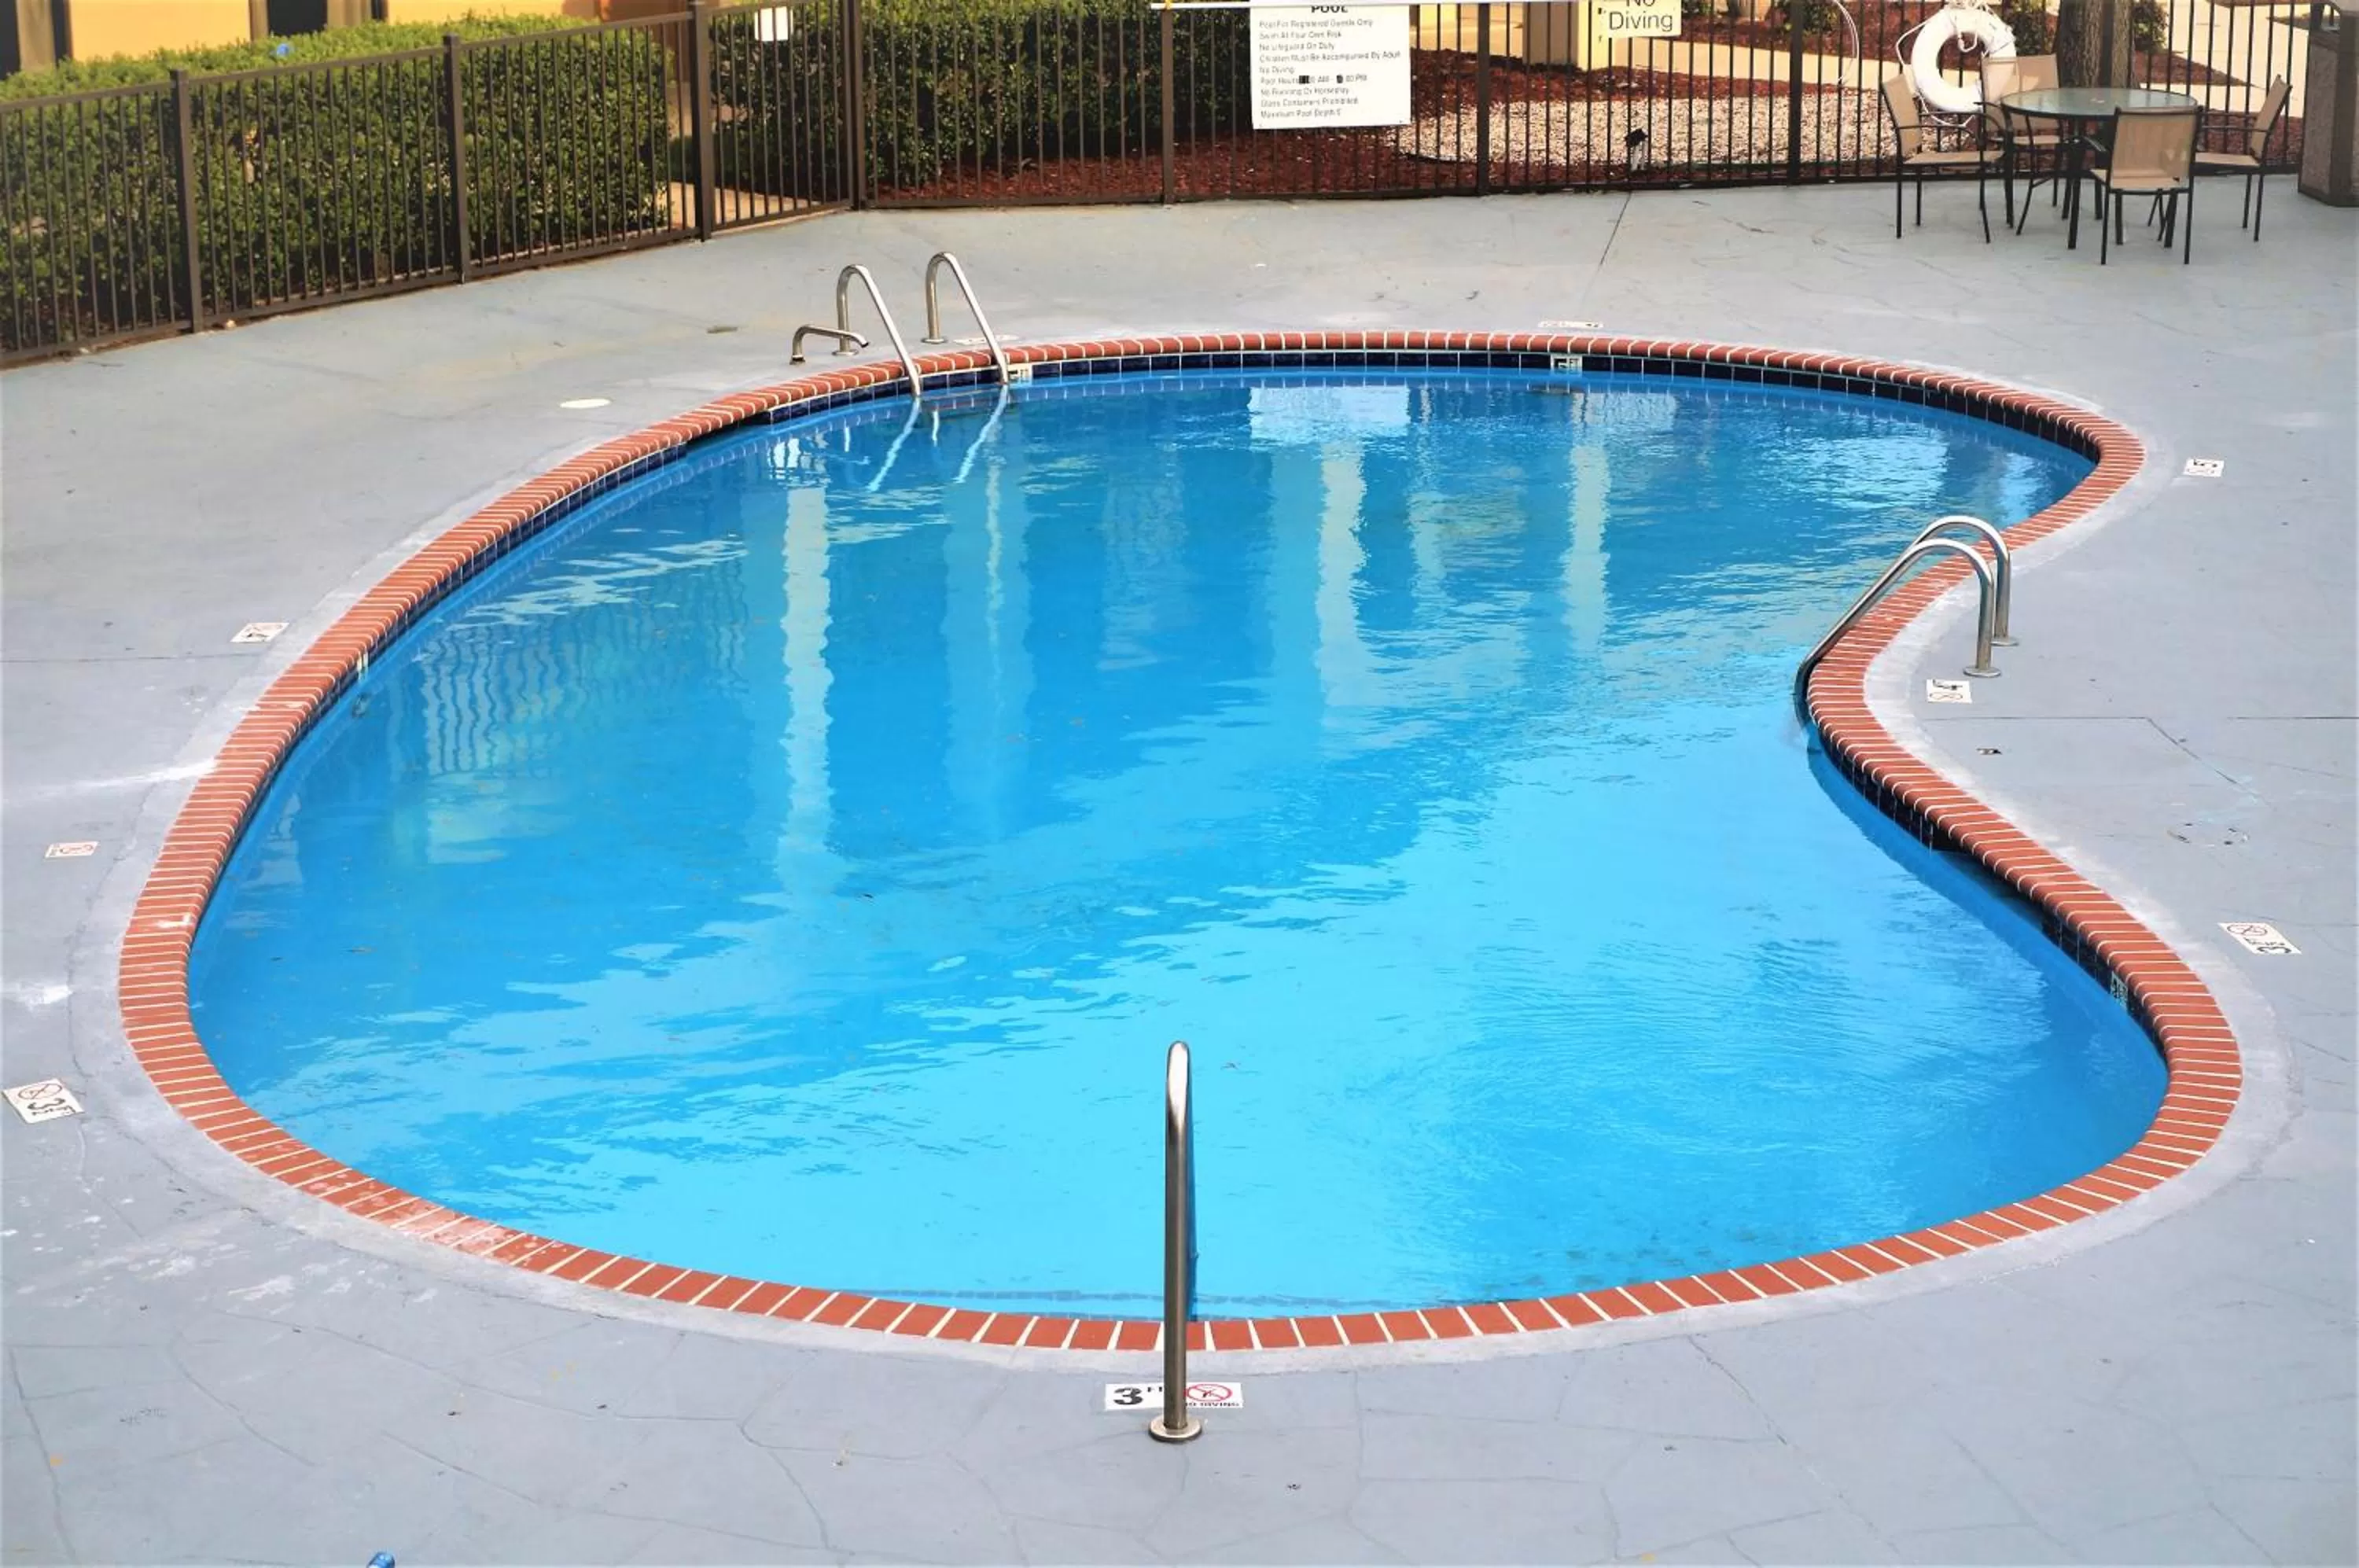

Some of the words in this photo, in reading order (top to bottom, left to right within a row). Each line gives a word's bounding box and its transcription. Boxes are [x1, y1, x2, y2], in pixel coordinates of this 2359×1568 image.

[1290, 20, 1329, 29] Registered
[1357, 18, 1373, 28] Only
[1609, 10, 1673, 32] Diving
[1259, 31, 1279, 40] Swim
[1327, 30, 1341, 39] Risk
[1259, 43, 1269, 52] No
[1272, 43, 1305, 53] Lifeguard
[1319, 42, 1334, 50] Duty
[1259, 53, 1290, 63] Children
[1290, 53, 1308, 62] Must
[1310, 53, 1320, 61] Be
[1322, 52, 1369, 62] Accompanied
[1371, 51, 1380, 61] By
[1272, 66, 1295, 75] Diving
[1272, 87, 1302, 97] Running
[1283, 98, 1320, 107] Containers
[1260, 110, 1295, 120] Maximum
[1296, 109, 1312, 118] Pool
[1314, 109, 1335, 118] Depth
[1113, 1386, 1144, 1406] 3
